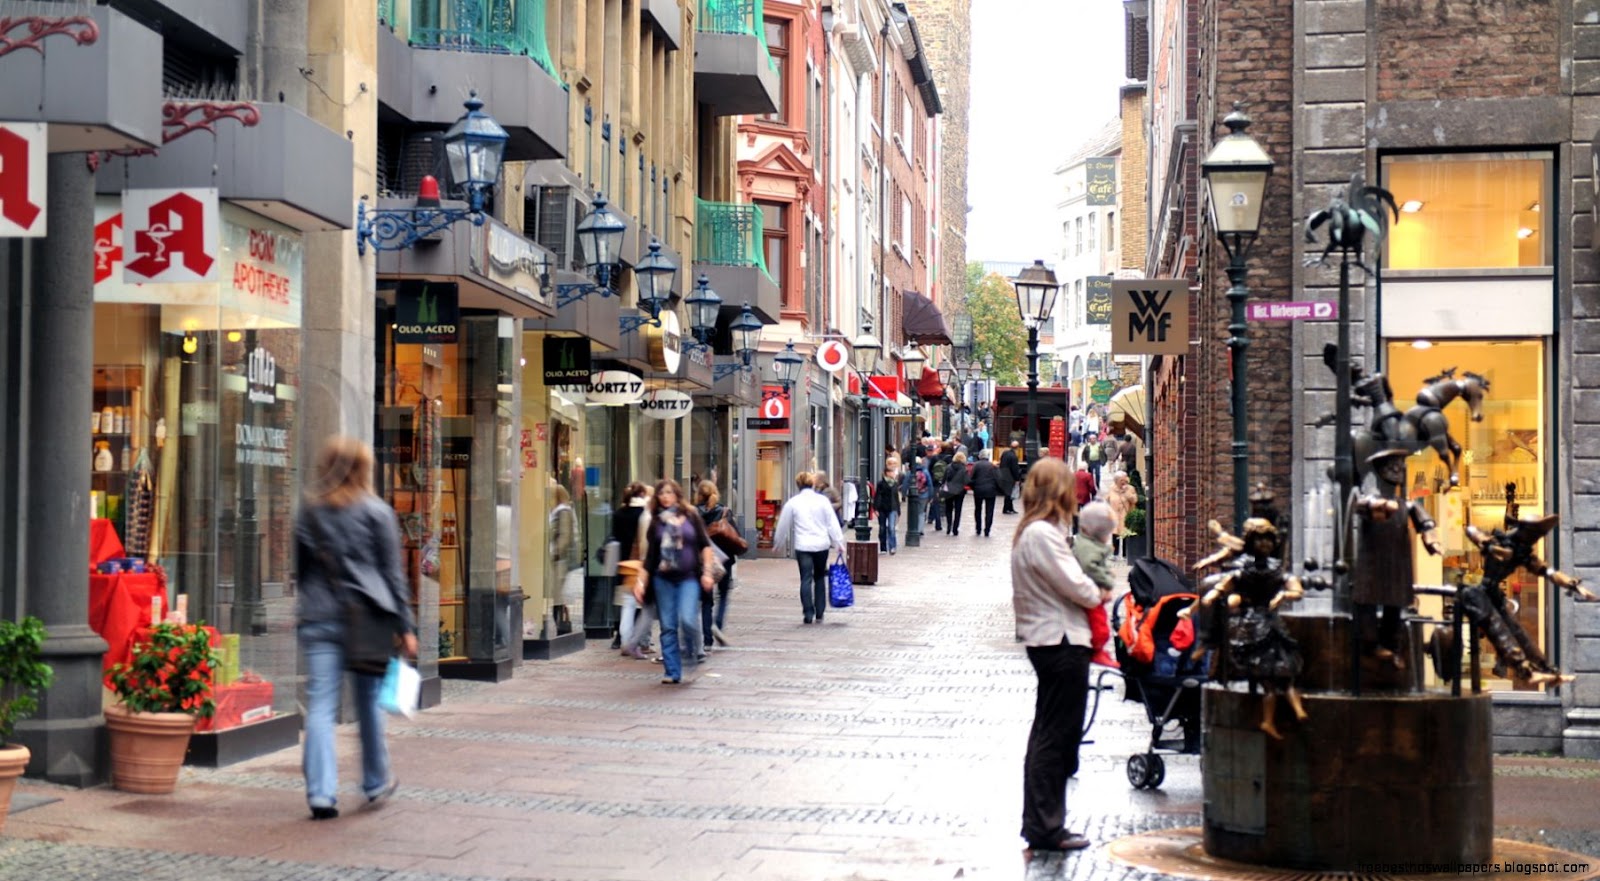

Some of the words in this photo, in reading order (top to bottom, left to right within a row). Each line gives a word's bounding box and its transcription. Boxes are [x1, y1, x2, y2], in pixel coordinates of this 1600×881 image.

[233, 262, 290, 304] APOTHEKE
[425, 324, 456, 334] ACETO
[565, 369, 589, 377] ACETO
[630, 382, 642, 393] 17
[680, 400, 691, 410] 17
